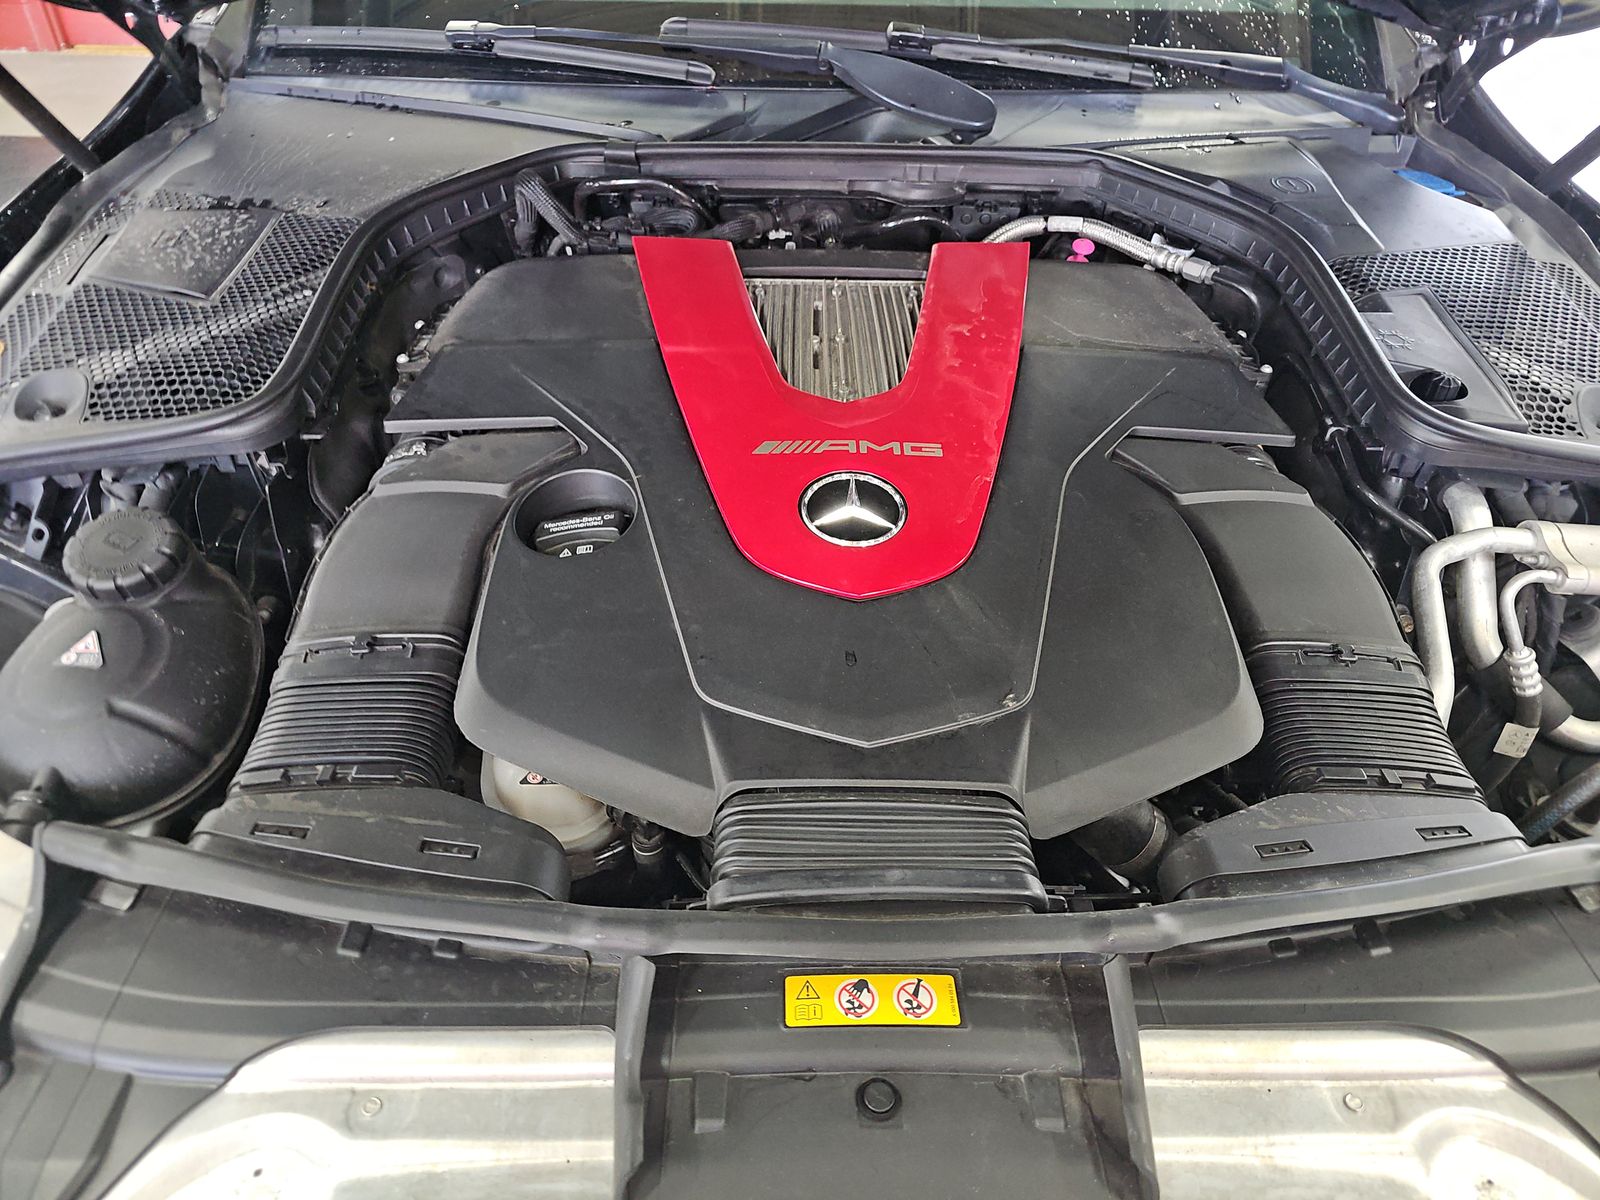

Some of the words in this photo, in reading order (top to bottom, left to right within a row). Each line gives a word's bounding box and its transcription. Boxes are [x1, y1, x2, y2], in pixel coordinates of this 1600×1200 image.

[812, 439, 944, 458] AMG
[544, 515, 602, 529] Mercedes-Benz
[549, 520, 604, 532] recommended
